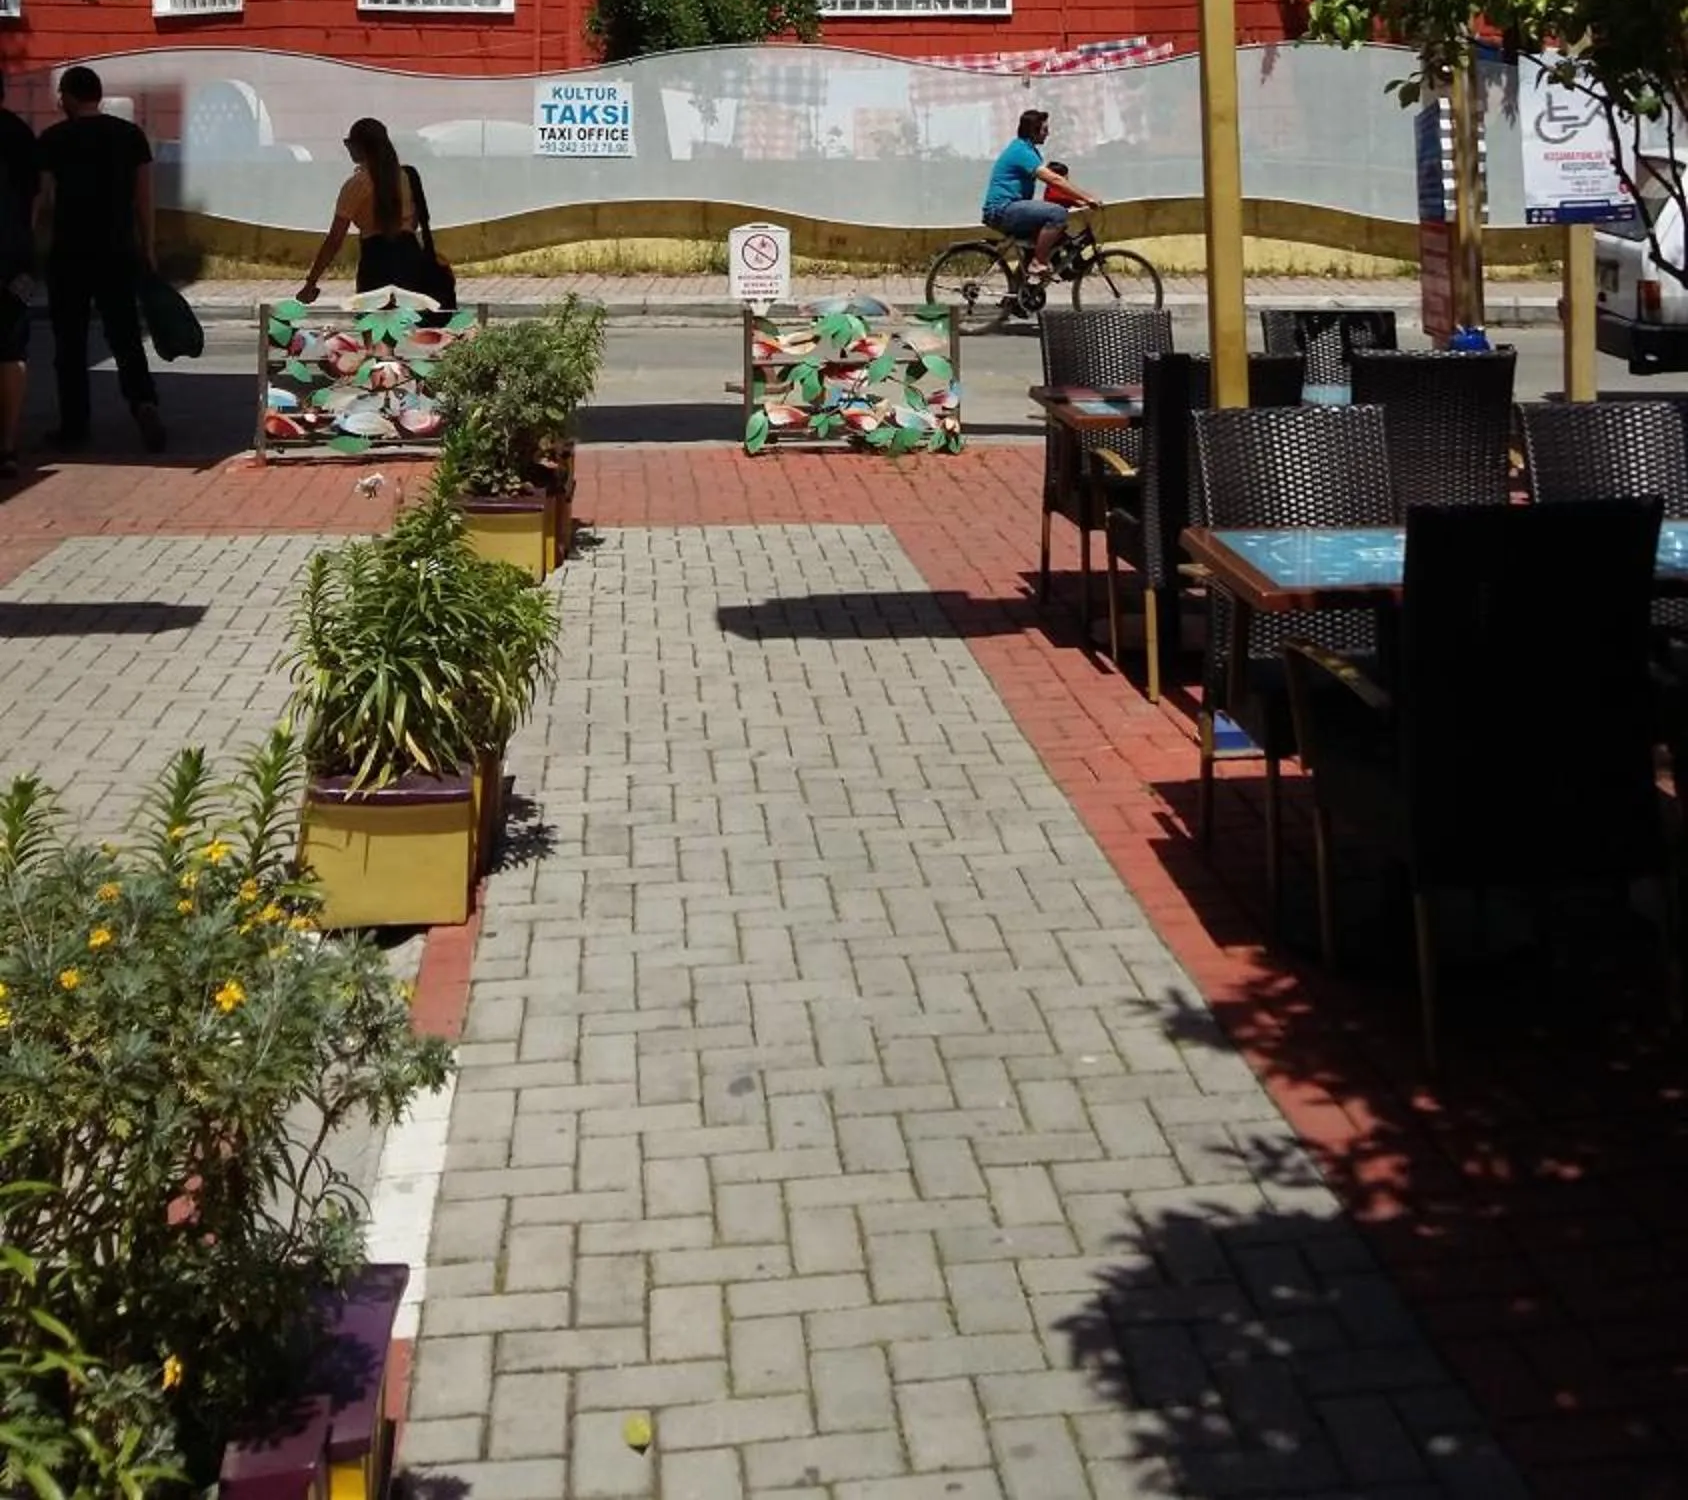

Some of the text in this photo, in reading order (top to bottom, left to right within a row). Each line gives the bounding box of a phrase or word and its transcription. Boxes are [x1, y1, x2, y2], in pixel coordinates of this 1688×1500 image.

[540, 100, 629, 125] TAKSİ
[538, 127, 629, 141] TAXI OFFICE
